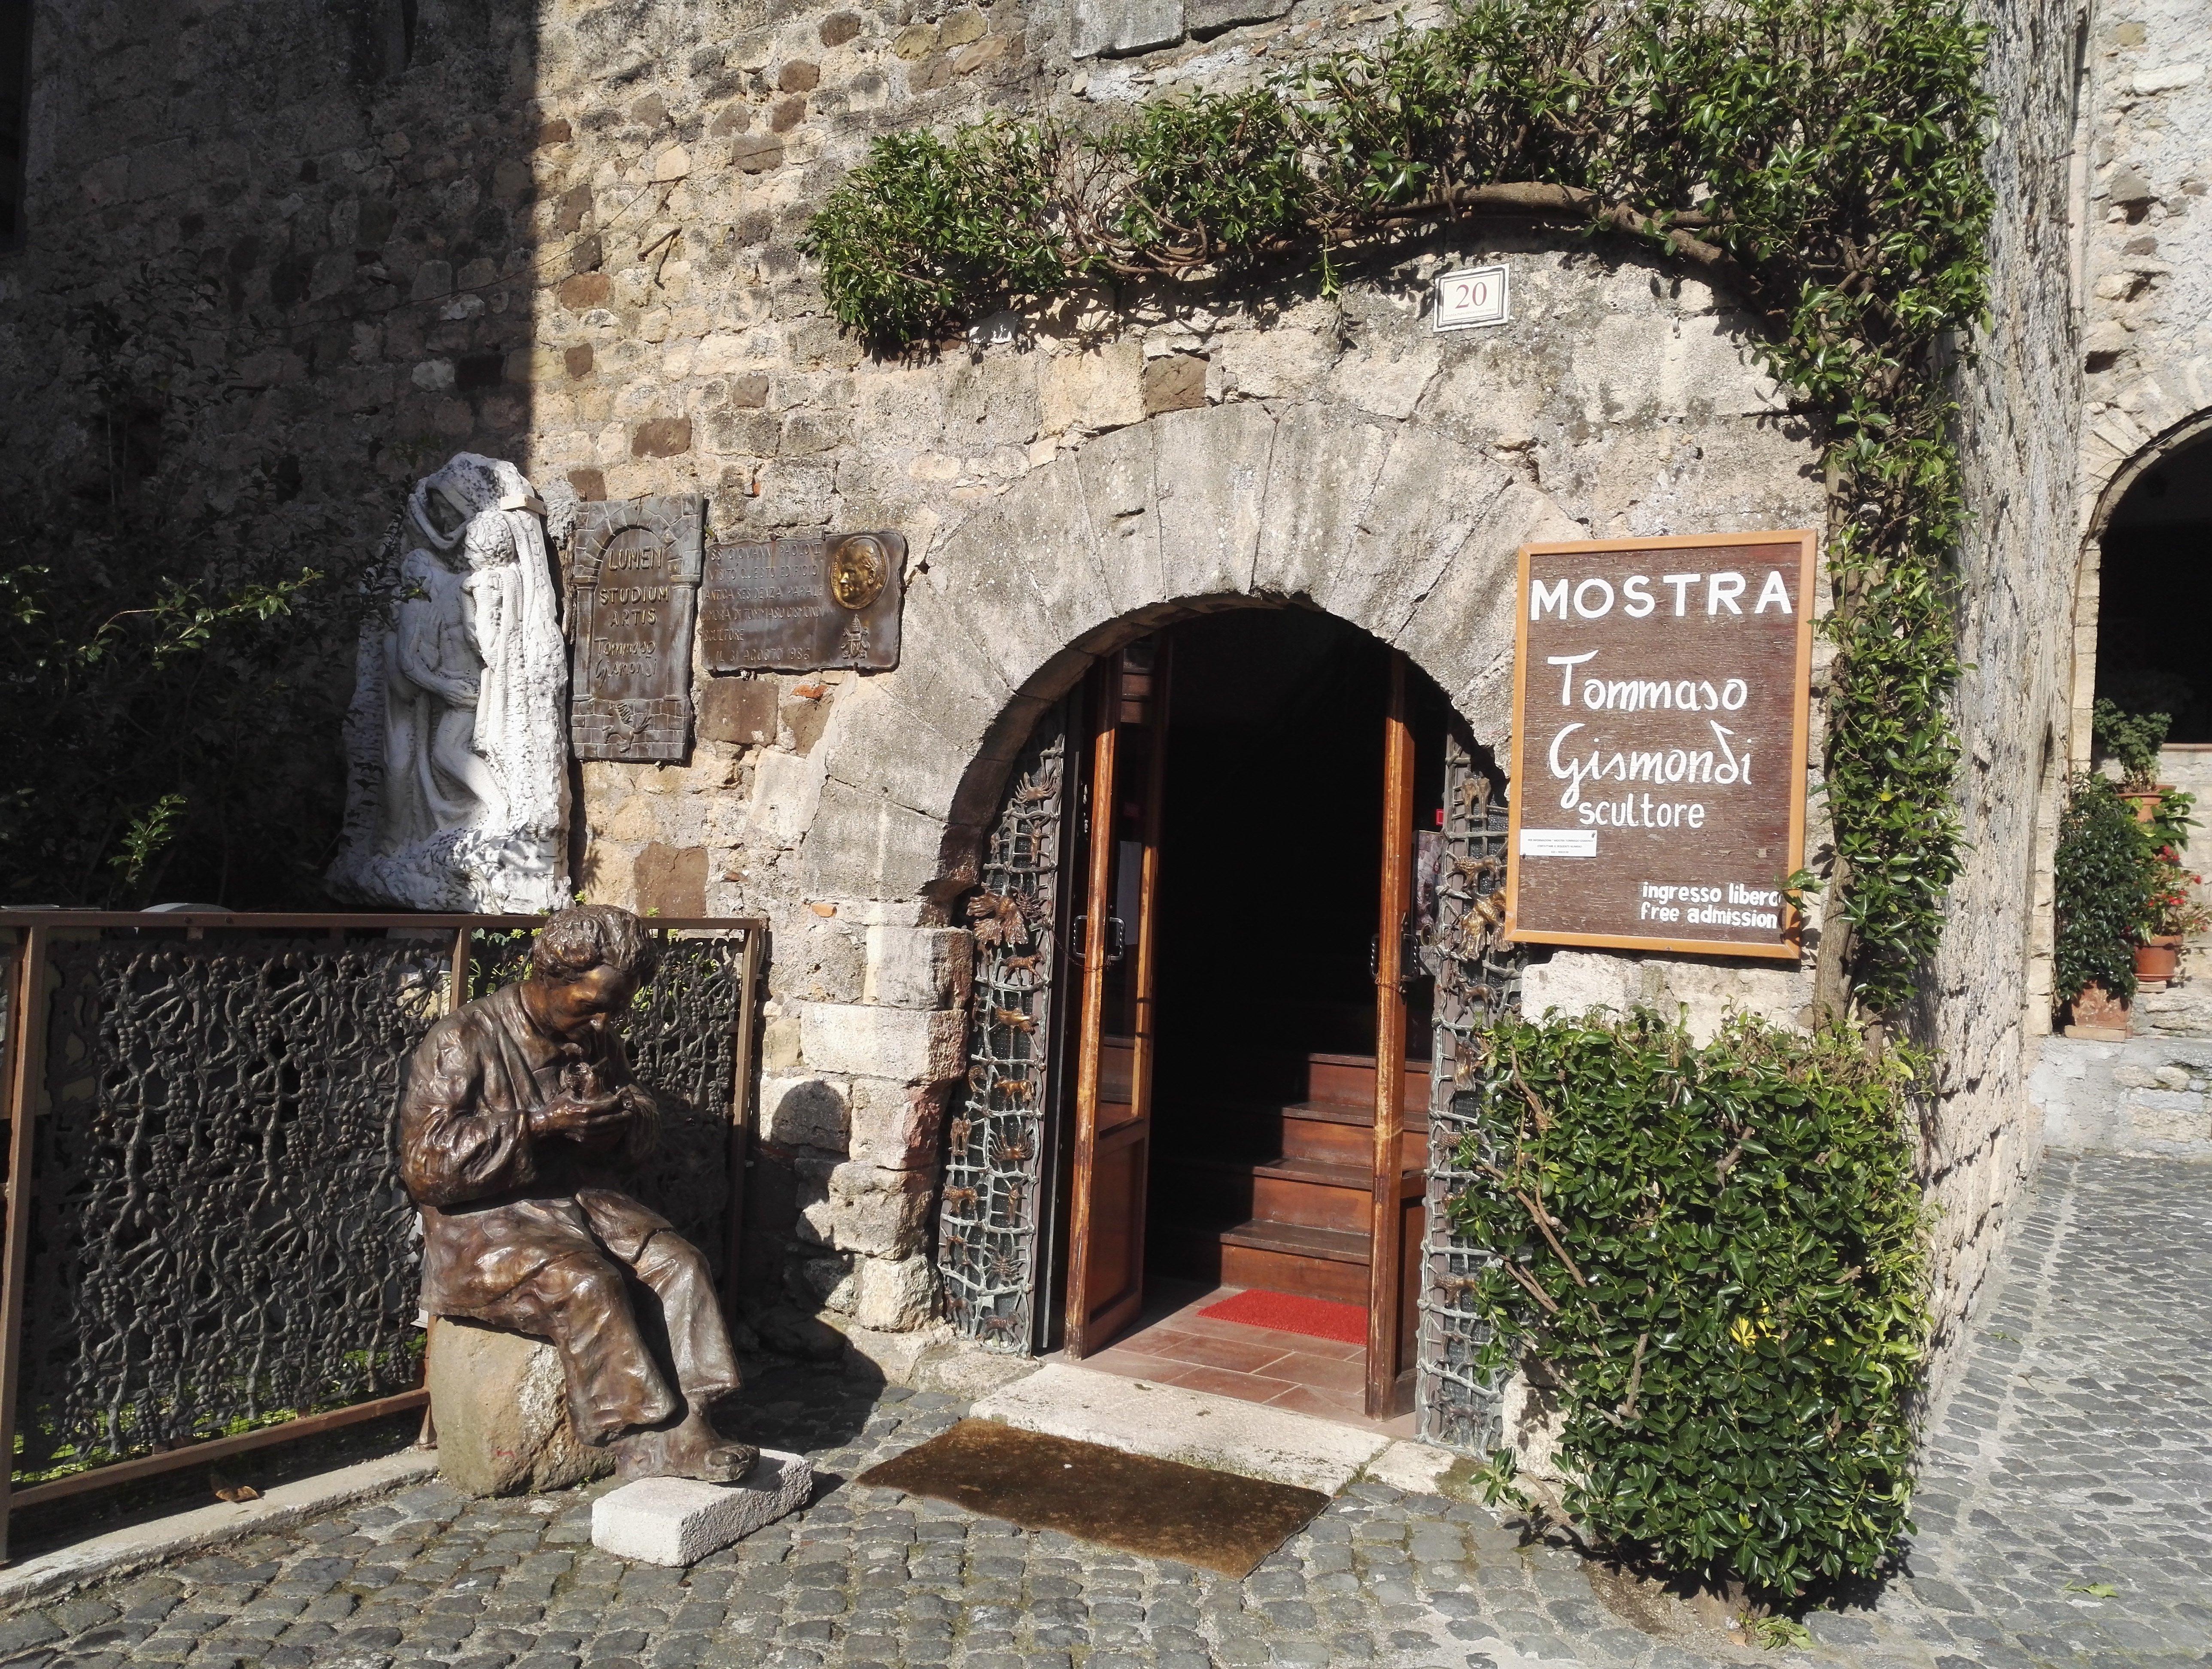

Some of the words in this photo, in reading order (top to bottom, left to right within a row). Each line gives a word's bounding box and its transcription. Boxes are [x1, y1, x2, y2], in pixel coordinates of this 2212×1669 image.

[1455, 282, 1487, 309] 20
[608, 546, 664, 571] LUMEN
[728, 546, 774, 560] GIOVANN
[780, 543, 810, 556] PAOLO
[741, 567, 776, 580] QUESTO
[599, 586, 670, 605] STUDIUM
[737, 586, 783, 600] RESIDENZA
[787, 585, 823, 598] PAPALE
[1531, 570, 1793, 621] MOSTRA
[610, 608, 657, 627] ARTIS
[703, 628, 745, 642] SCULTORE
[594, 637, 656, 658] Tommaso
[744, 648, 783, 662] AGOSTO
[788, 647, 810, 660] 1986
[1547, 649, 1747, 712] Tommaso
[1549, 719, 1752, 809] Gismondi
[1578, 793, 1705, 828] scultore
[1642, 881, 1722, 904] ingresso
[1729, 883, 1781, 907] libero
[1641, 901, 1680, 922] free
[1687, 904, 1778, 929] admission
